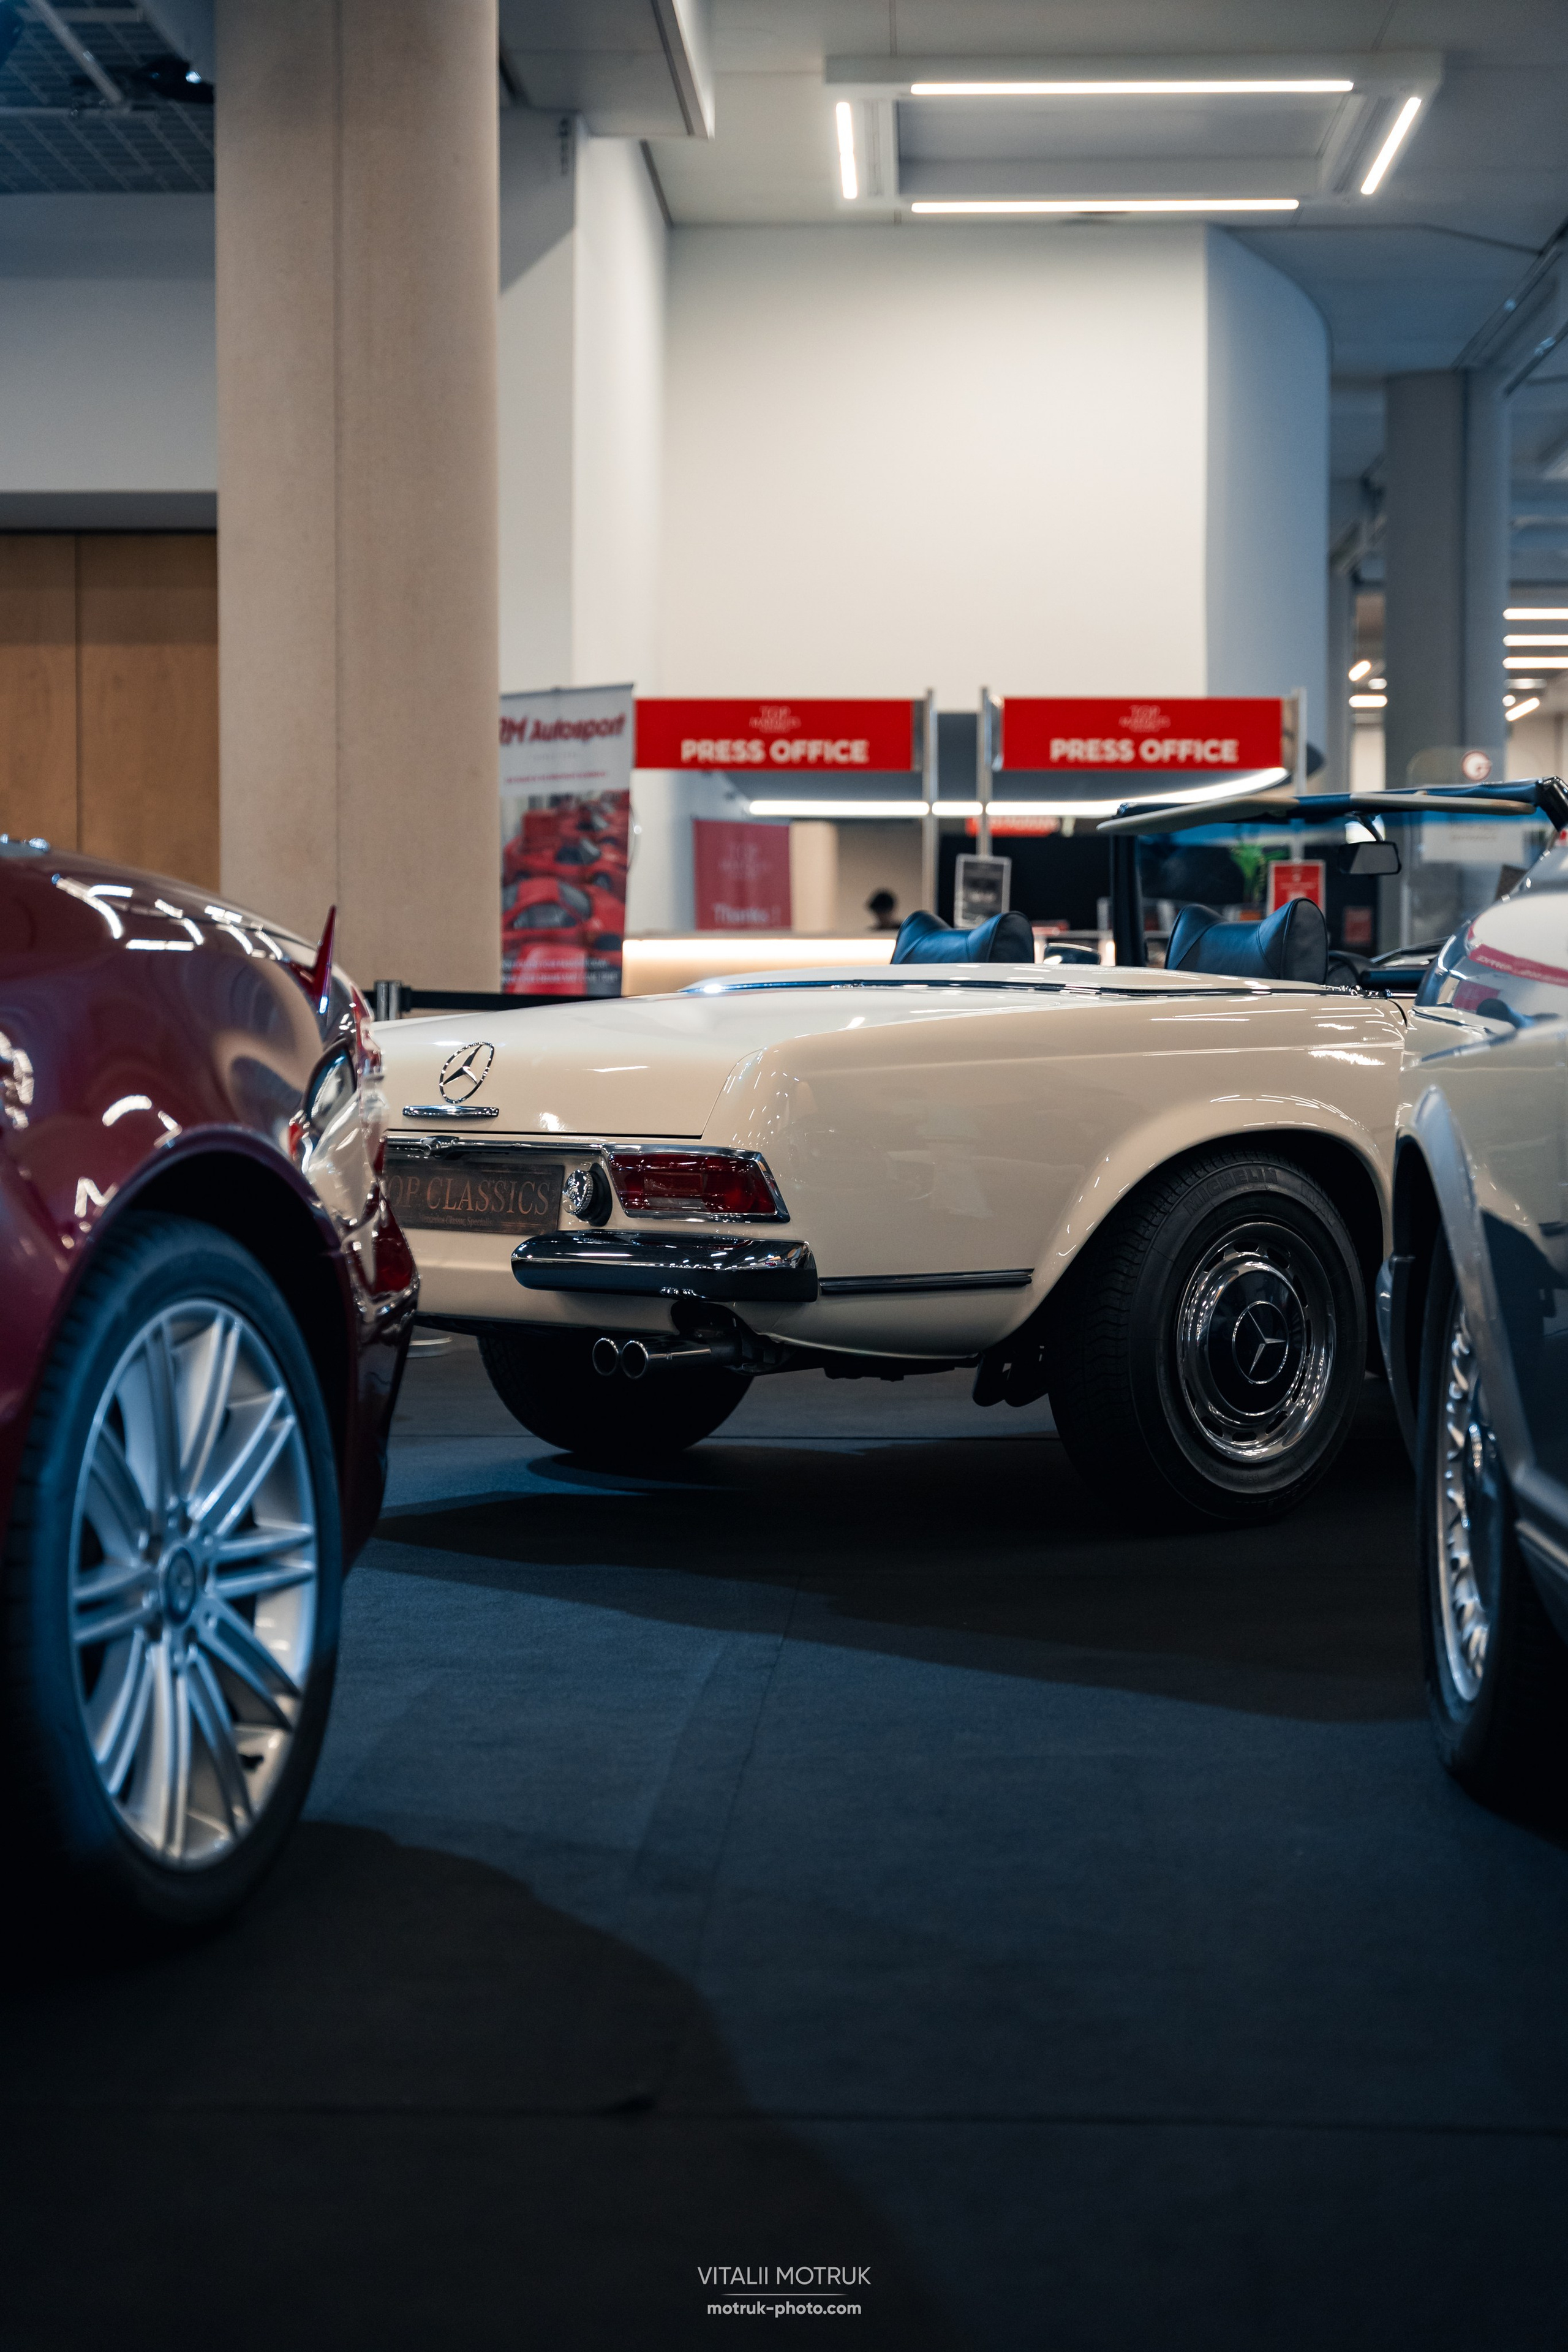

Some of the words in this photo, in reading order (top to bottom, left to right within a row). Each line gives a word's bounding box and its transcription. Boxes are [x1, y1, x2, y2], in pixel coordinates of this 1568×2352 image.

[529, 713, 626, 743] Autosport
[681, 739, 765, 763] PRESS
[769, 738, 870, 764] OFFICE
[1050, 737, 1135, 763] PRESS
[1139, 737, 1239, 763] OFFICE
[386, 1175, 421, 1208] OP
[426, 1177, 551, 1215] CLASSICS
[1183, 1166, 1278, 1216] MICHELIN
